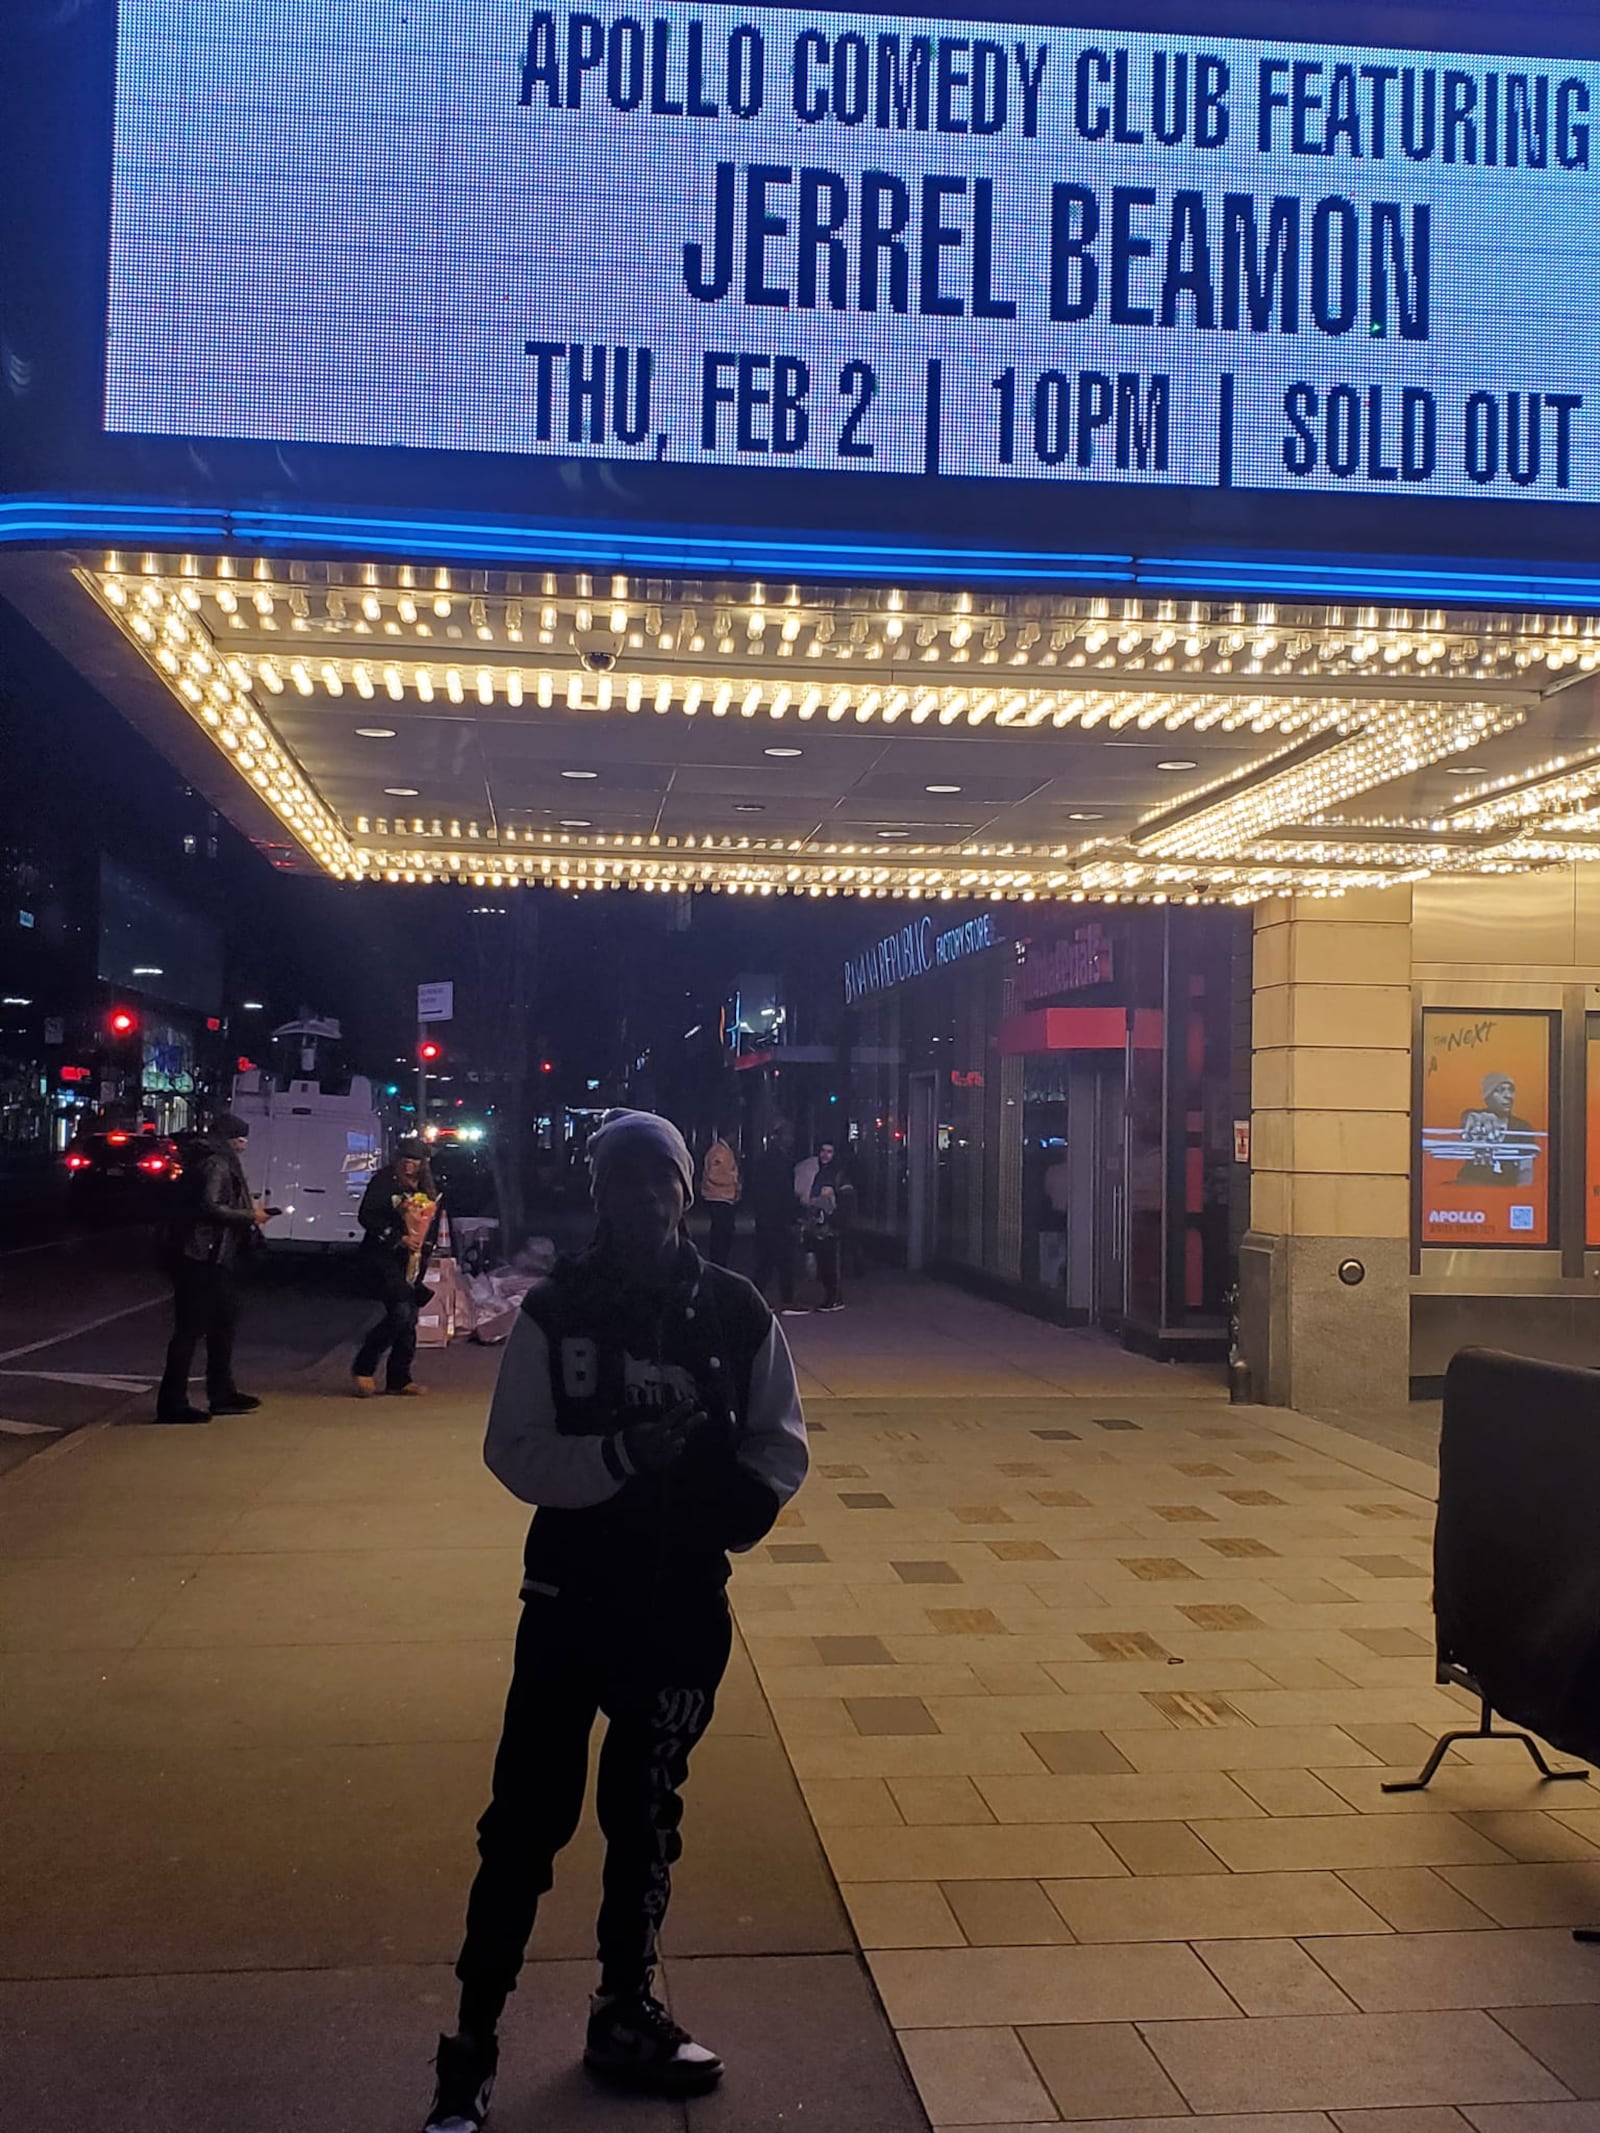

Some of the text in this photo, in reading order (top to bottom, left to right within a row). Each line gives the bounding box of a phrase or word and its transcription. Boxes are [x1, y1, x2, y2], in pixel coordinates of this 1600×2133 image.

[519, 10, 1589, 170] APOLLO COMEDY CLUB FEATURING
[683, 161, 1430, 341] JERREL BEAMON
[525, 340, 668, 463] THU,
[701, 351, 810, 454] FEB
[837, 359, 877, 458] 2
[992, 367, 1170, 471] 10PM
[1282, 381, 1436, 482] SOLD
[1465, 390, 1582, 489] OUT
[877, 914, 933, 990] REPUBLIC
[964, 912, 992, 955] STORE
[1447, 1020, 1497, 1052] NEXT
[1429, 1210, 1486, 1223] APOLLO
